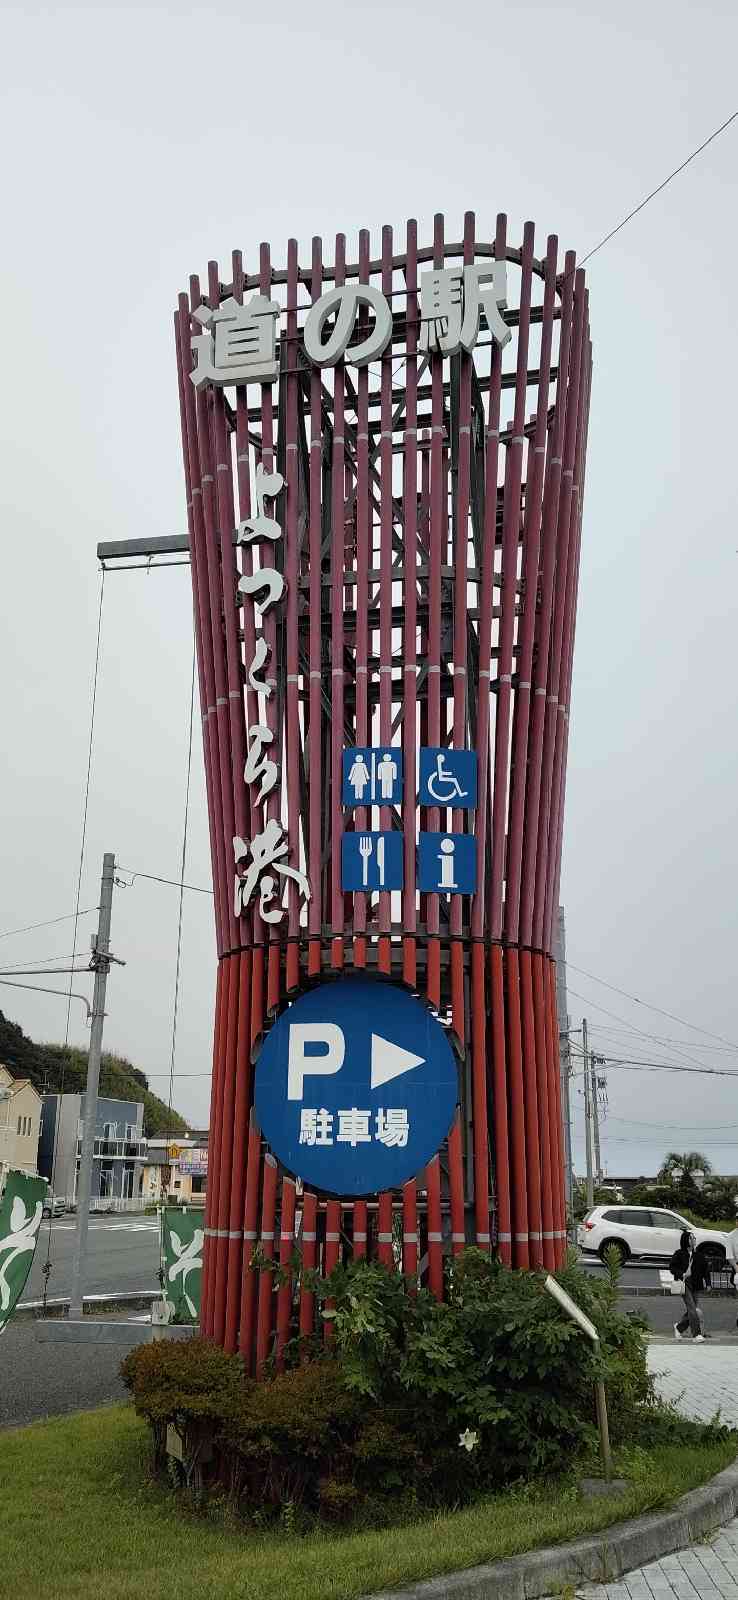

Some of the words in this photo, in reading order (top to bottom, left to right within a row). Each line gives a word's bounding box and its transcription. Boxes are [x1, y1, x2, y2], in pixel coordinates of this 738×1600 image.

[189, 259, 512, 387] 道の駅
[233, 462, 312, 924] よつくら港
[287, 1022, 346, 1101] P
[299, 1107, 410, 1148] 駐車場
